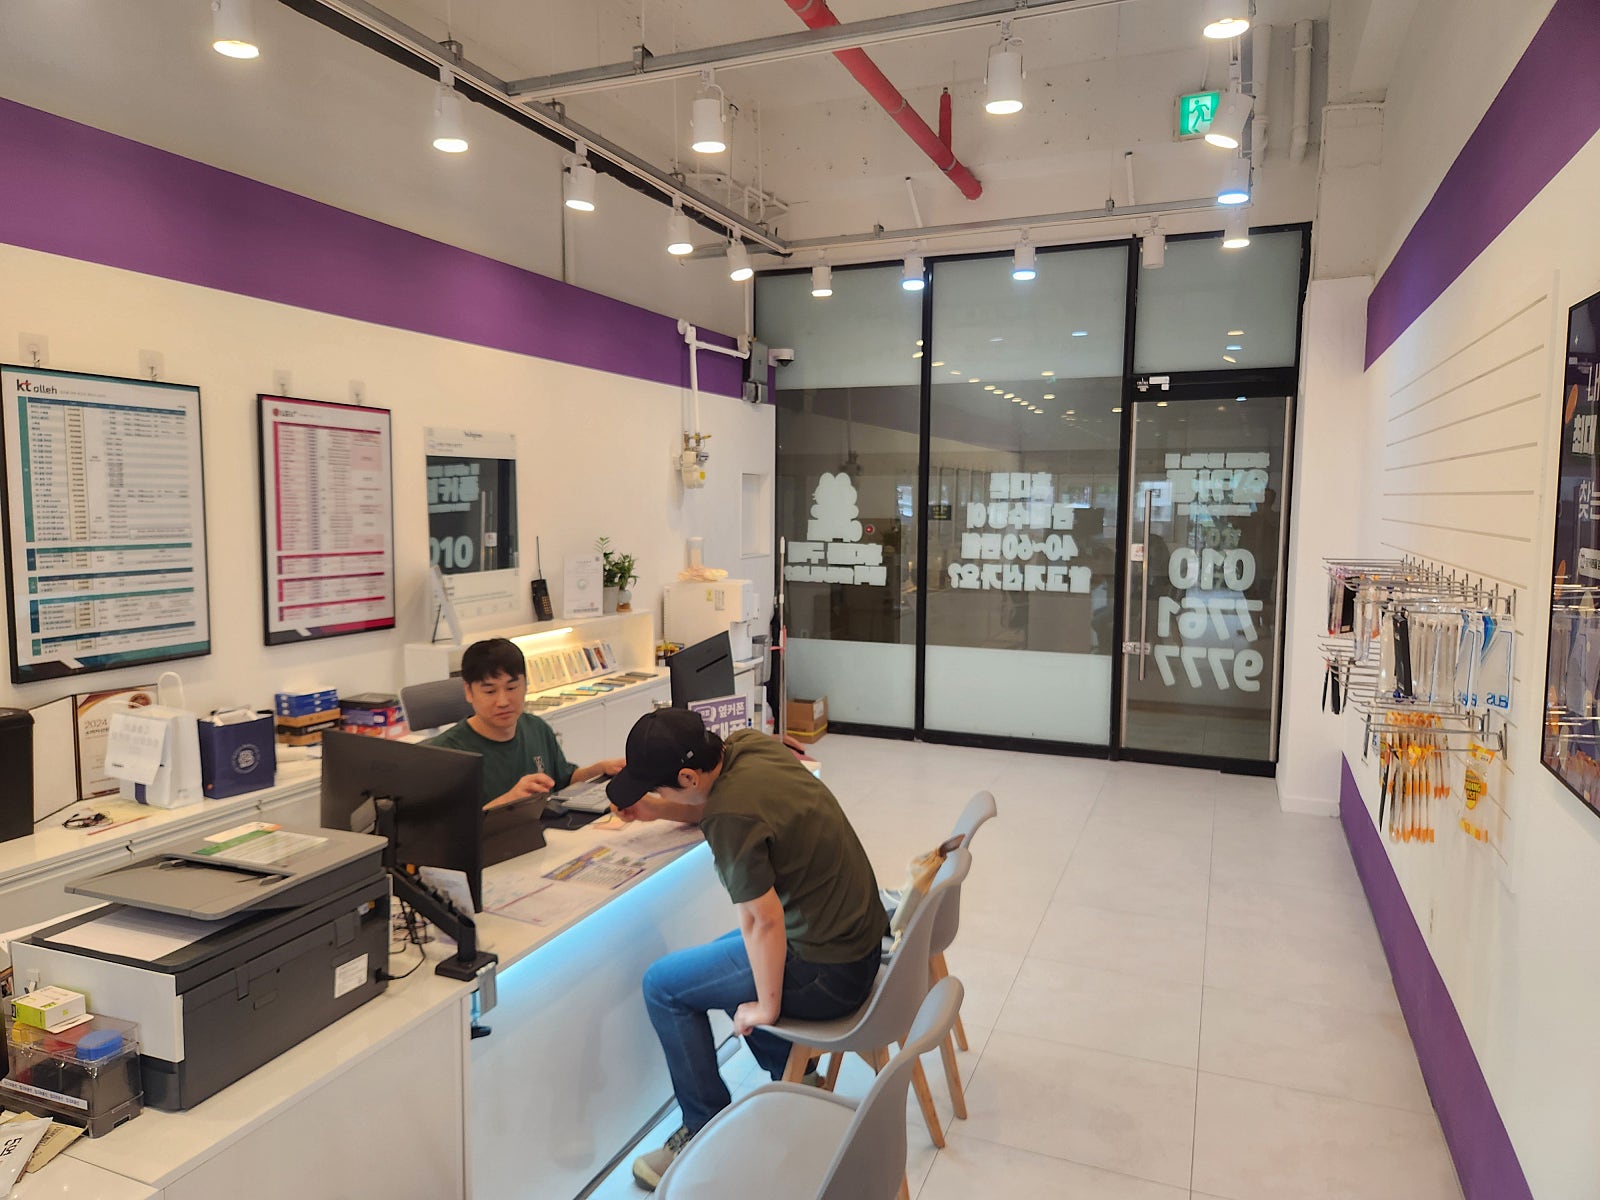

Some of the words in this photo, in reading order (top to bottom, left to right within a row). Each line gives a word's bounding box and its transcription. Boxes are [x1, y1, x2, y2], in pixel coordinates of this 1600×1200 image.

[16, 379, 32, 392] kt
[33, 386, 58, 395] olleh
[718, 702, 745, 718] 옆커폰
